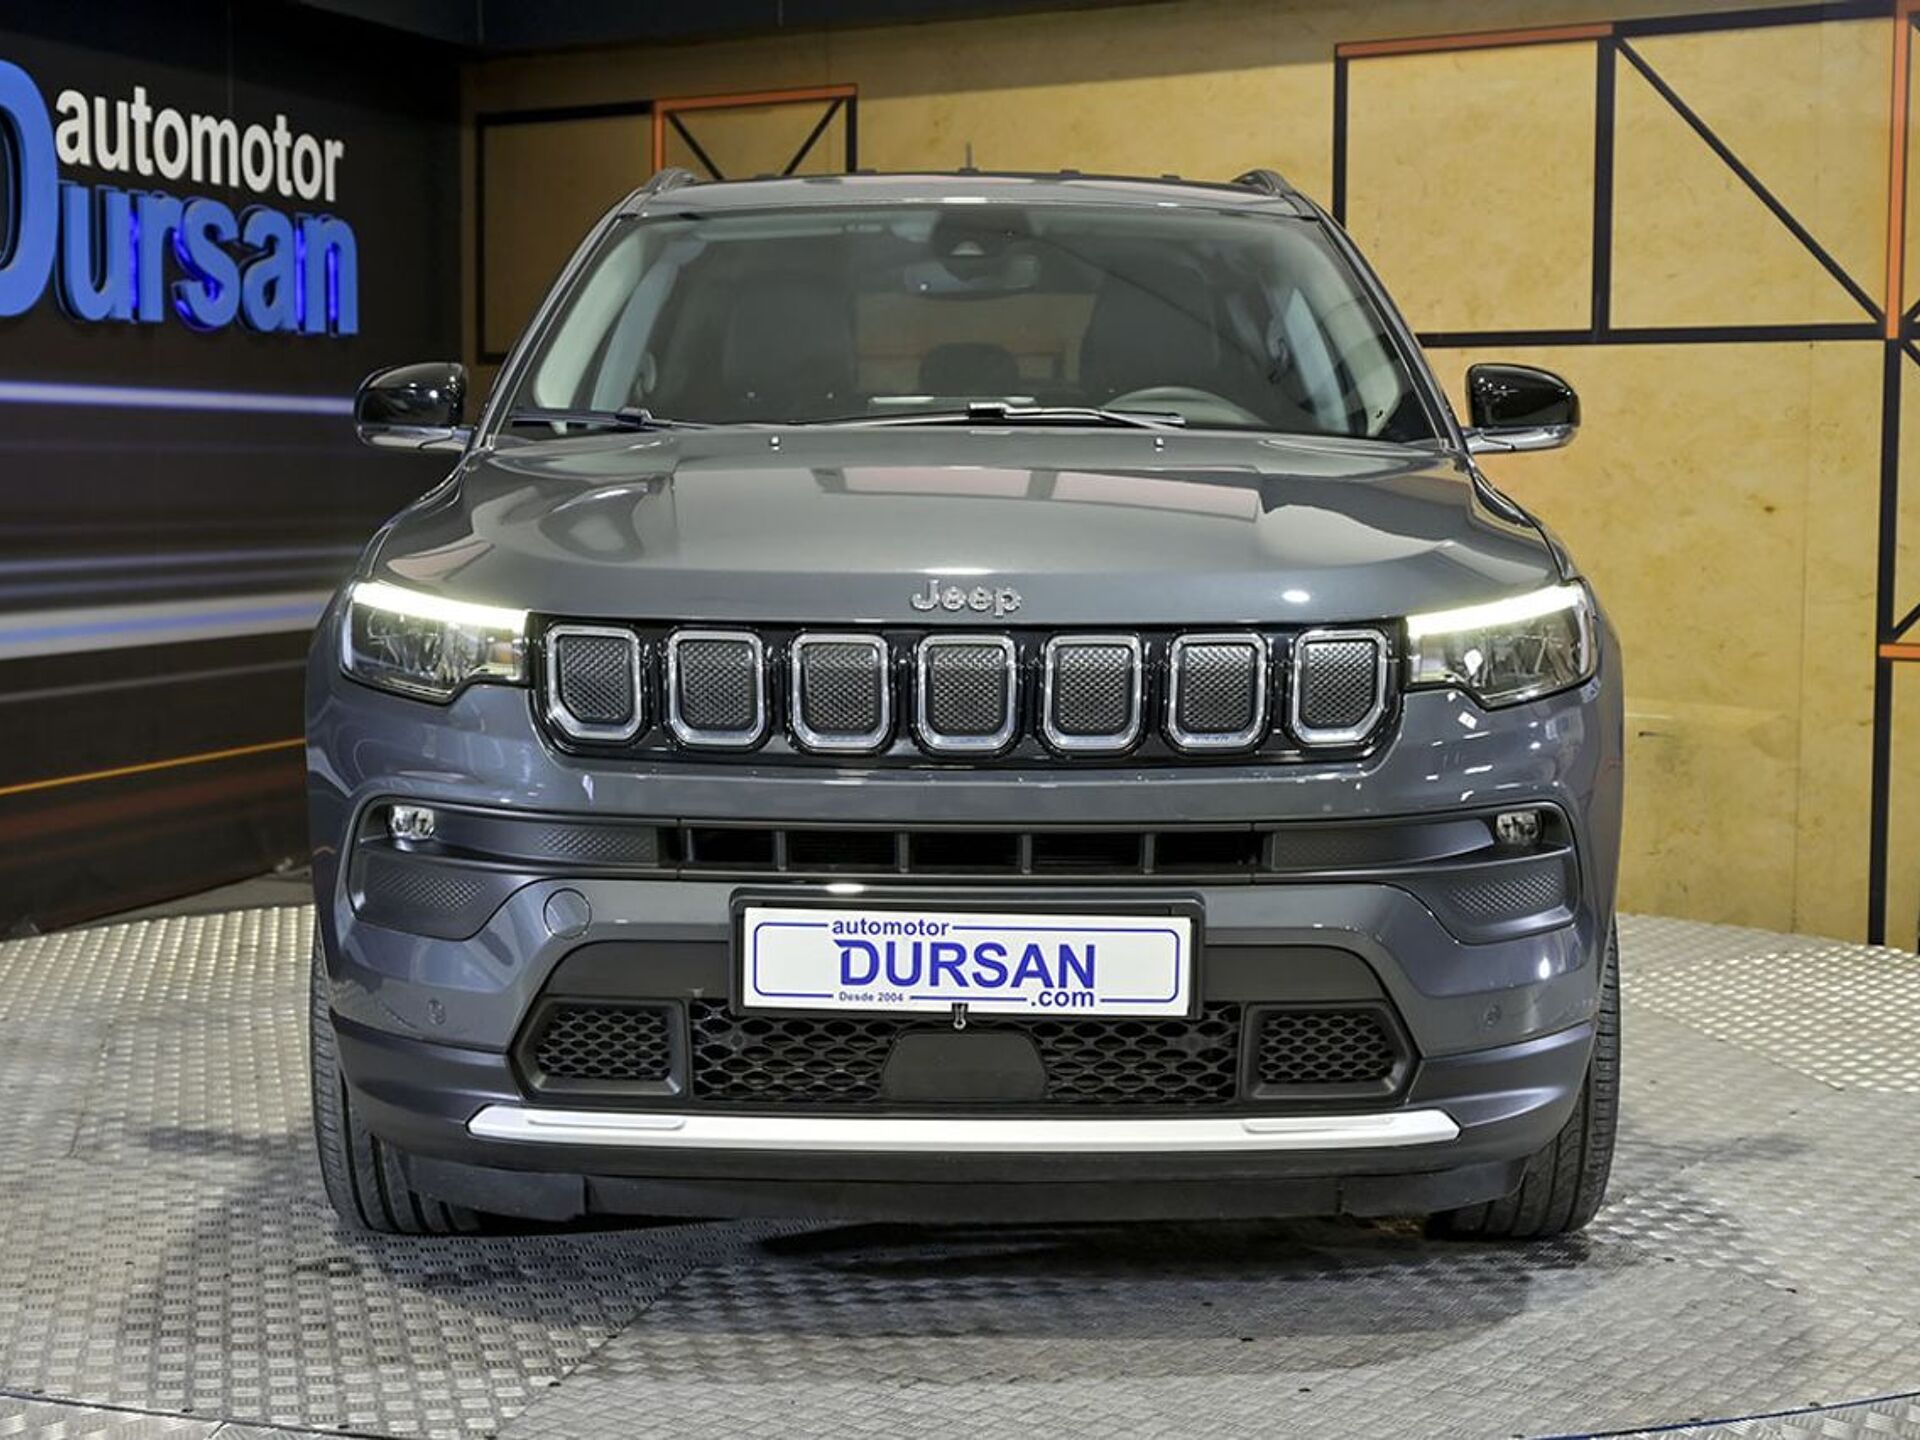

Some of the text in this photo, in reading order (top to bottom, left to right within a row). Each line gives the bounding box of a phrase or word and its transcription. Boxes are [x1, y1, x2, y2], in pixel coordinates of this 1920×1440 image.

[55, 86, 344, 202] automotor
[910, 579, 1022, 618] Jeep
[832, 918, 950, 936] automotor
[833, 939, 1096, 989] DURSAN
[1031, 990, 1095, 1007] .com
